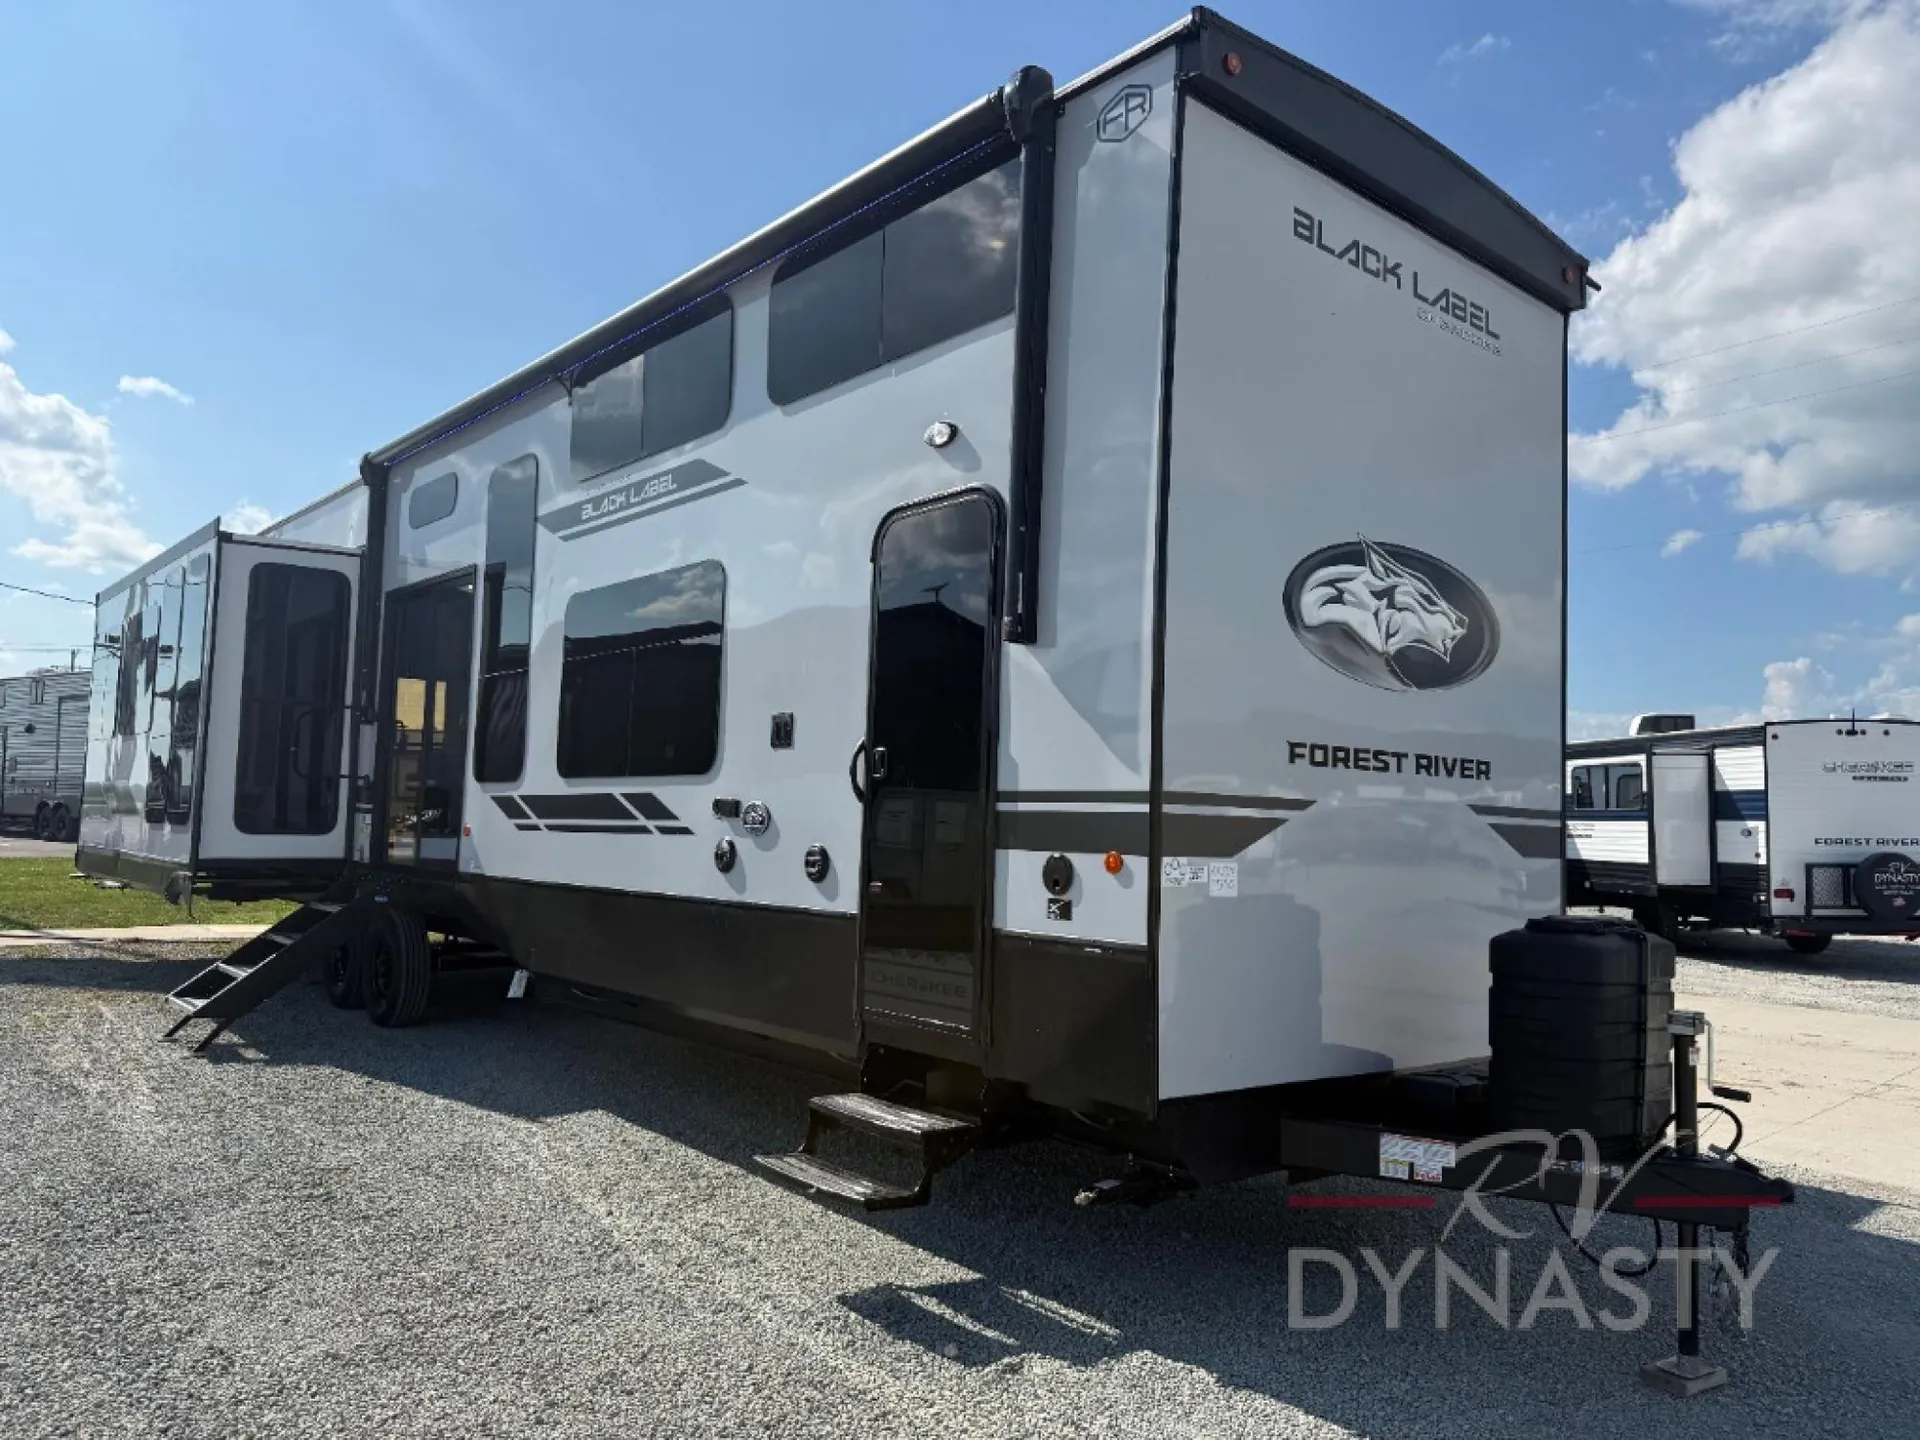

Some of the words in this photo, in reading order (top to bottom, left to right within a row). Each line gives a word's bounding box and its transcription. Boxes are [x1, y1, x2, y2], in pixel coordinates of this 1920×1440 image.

[1293, 205, 1403, 290] BLACK
[1413, 271, 1501, 340] LABEL
[581, 491, 628, 520] BLACK
[629, 473, 678, 503] LABEL
[1286, 740, 1409, 774] FOREST
[1414, 753, 1492, 781] RIVER
[1814, 837, 1872, 846] FOREST
[1876, 837, 1919, 846] RIVER
